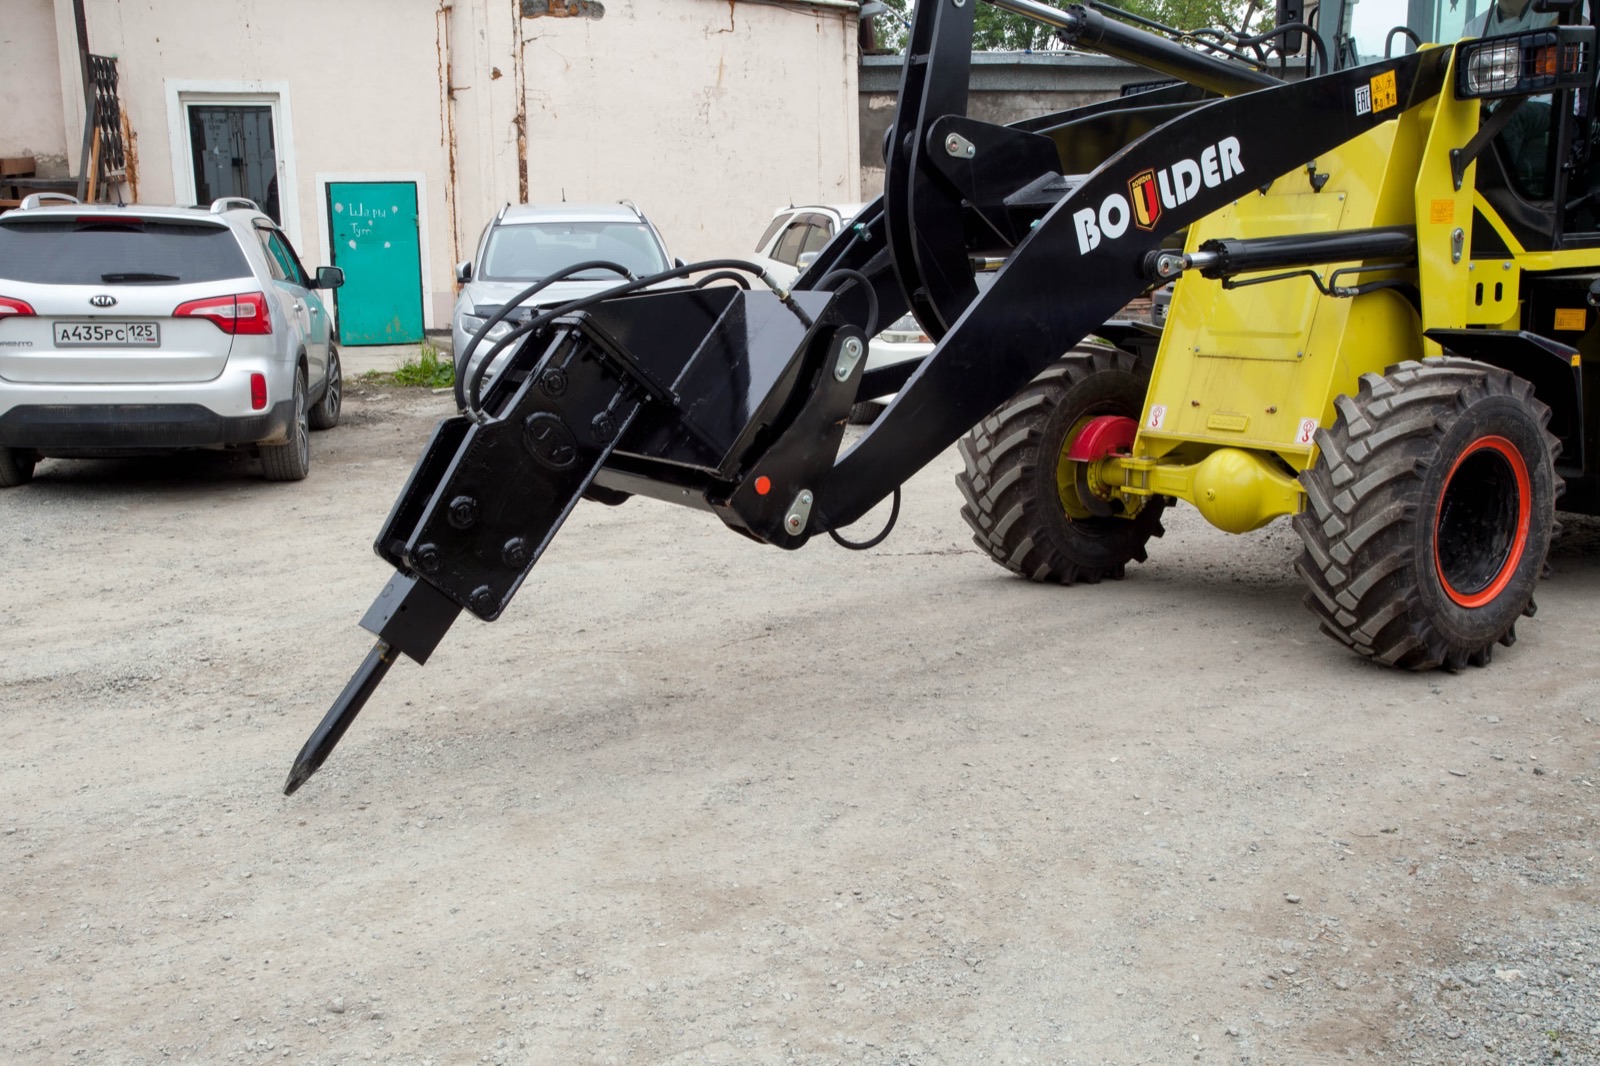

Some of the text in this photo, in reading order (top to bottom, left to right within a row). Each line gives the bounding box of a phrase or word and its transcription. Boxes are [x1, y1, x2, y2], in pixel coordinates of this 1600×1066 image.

[1073, 136, 1245, 255] BOULDER
[93, 296, 113, 305] KIA
[128, 325, 153, 337] 125
